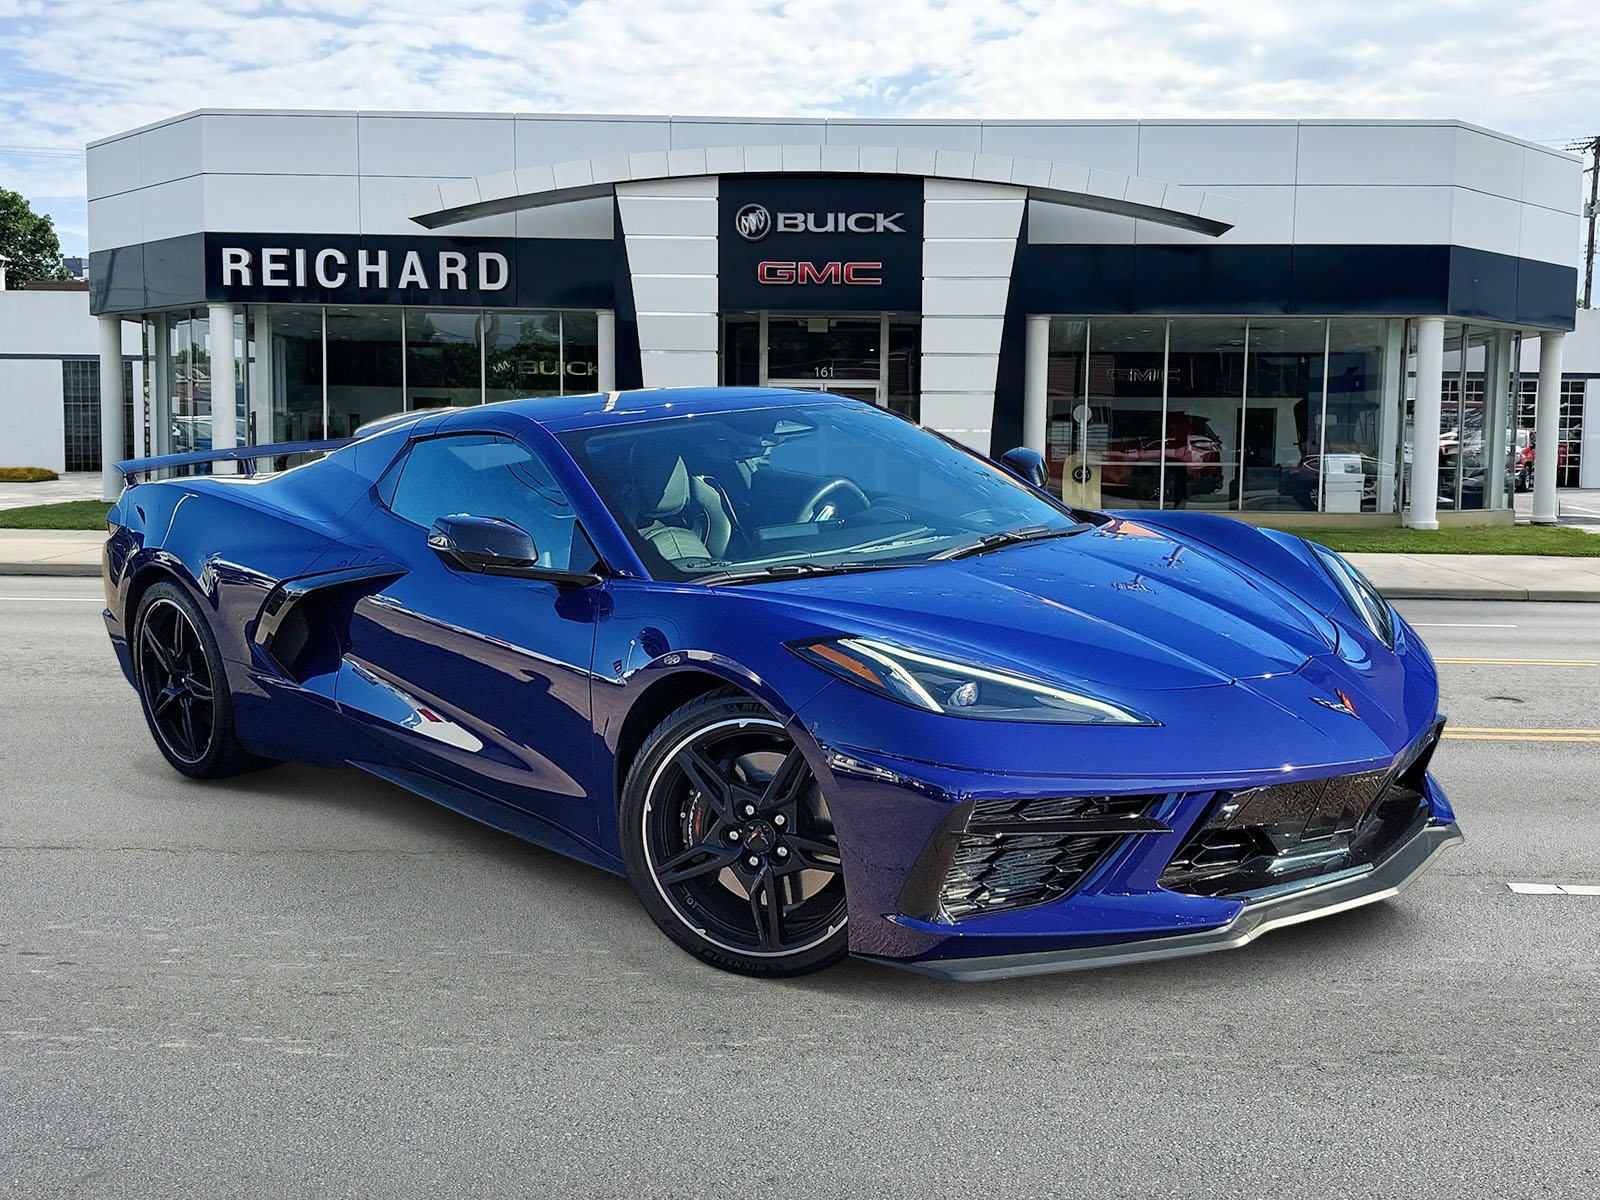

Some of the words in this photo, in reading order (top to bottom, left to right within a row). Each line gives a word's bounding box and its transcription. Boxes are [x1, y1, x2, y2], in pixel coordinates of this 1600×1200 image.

[776, 211, 906, 233] BUICK
[221, 246, 510, 292] REICHARD
[757, 261, 882, 285] GMC
[814, 366, 834, 378] 161
